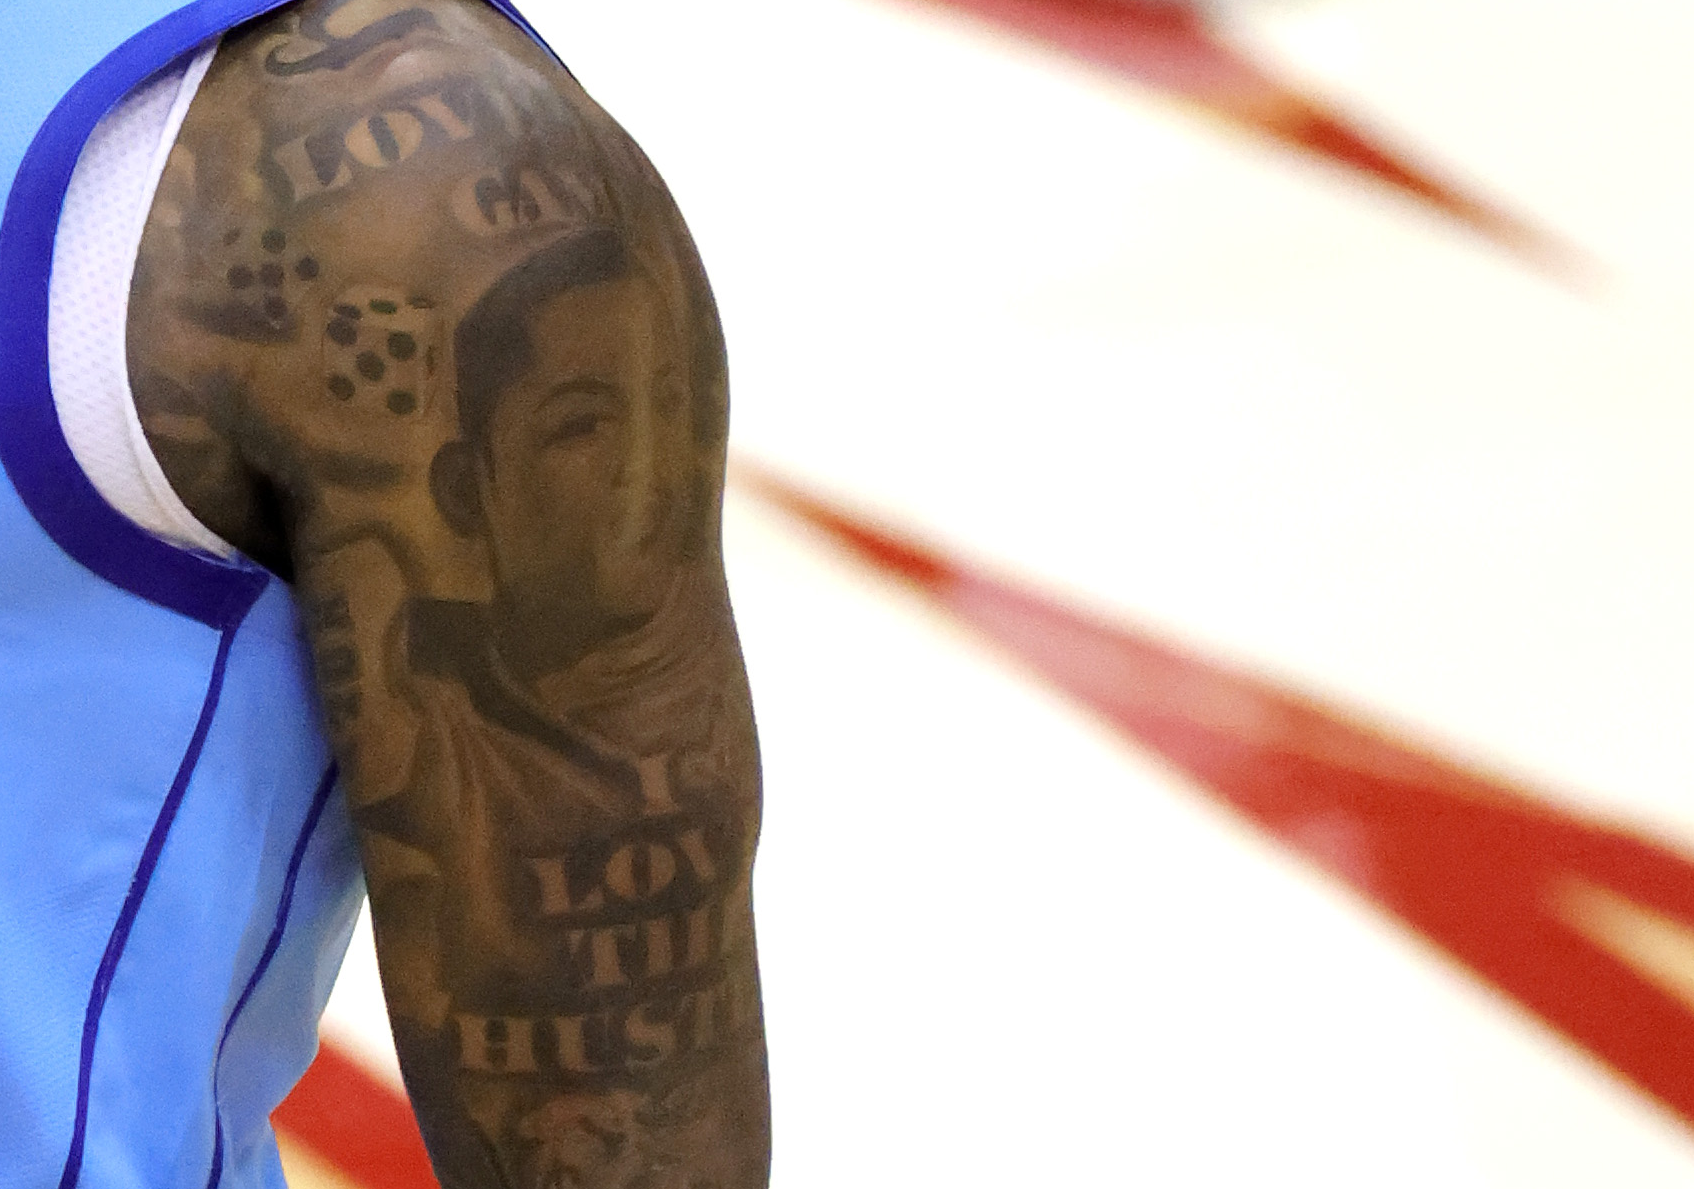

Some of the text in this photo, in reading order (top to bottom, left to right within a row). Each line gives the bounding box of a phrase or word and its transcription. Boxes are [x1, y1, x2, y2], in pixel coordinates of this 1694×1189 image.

[526, 827, 718, 916] LOV
[567, 907, 712, 989] TH
[455, 987, 724, 1074] HUST
